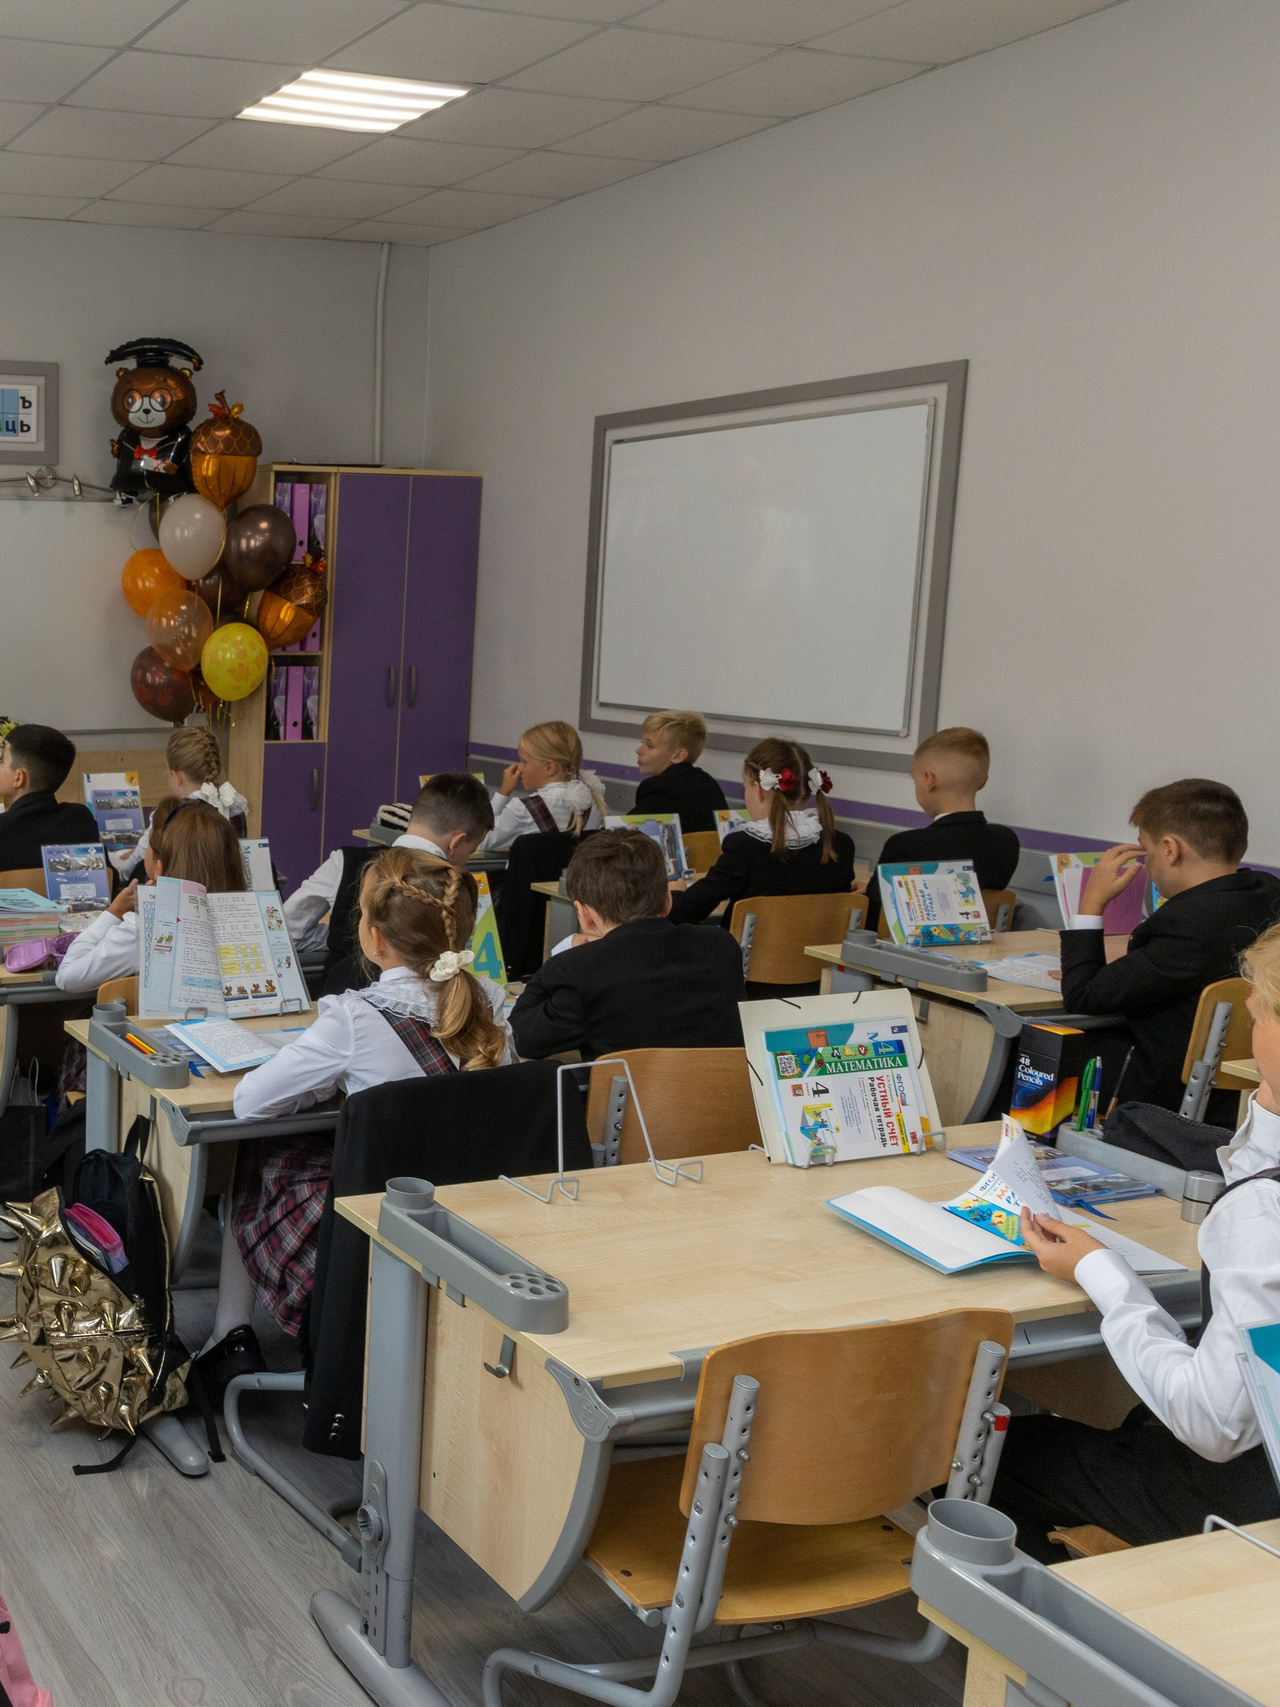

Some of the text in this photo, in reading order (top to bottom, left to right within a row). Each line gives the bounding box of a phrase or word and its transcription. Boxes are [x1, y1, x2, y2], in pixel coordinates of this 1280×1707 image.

[473, 931, 503, 979] 4
[825, 1056, 903, 1074] МАТЕМАТИКА
[1019, 1057, 1030, 1066] 48
[1017, 1072, 1043, 1086] Pencils
[1018, 1064, 1054, 1081] Coloured
[812, 1082, 830, 1098] 4
[896, 1074, 906, 1098] ФГОС
[868, 1076, 888, 1148] Рабочая тетрадь
[876, 1075, 899, 1147] УСТНЫЙ СЧЁТ
